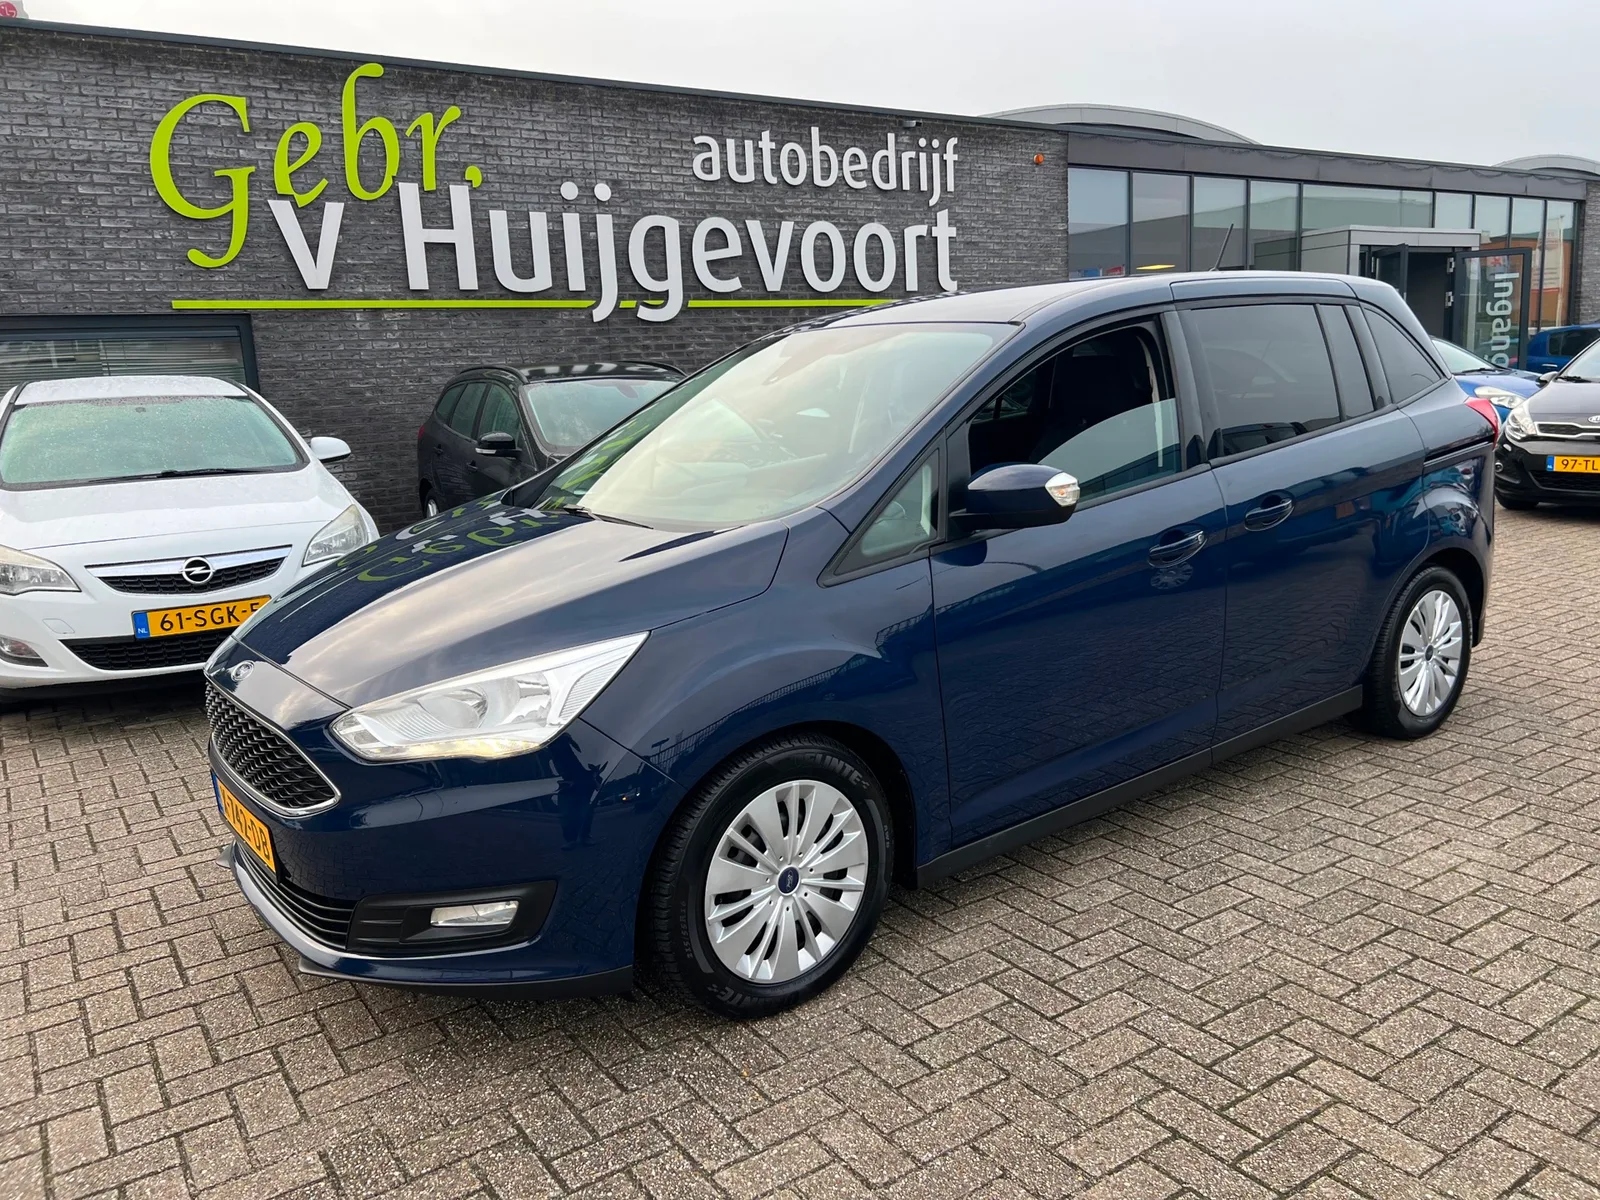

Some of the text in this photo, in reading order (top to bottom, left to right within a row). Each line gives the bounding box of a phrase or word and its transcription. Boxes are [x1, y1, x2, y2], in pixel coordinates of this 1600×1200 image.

[692, 127, 958, 207] autobedrijf
[267, 181, 958, 323] v Huijgevoort
